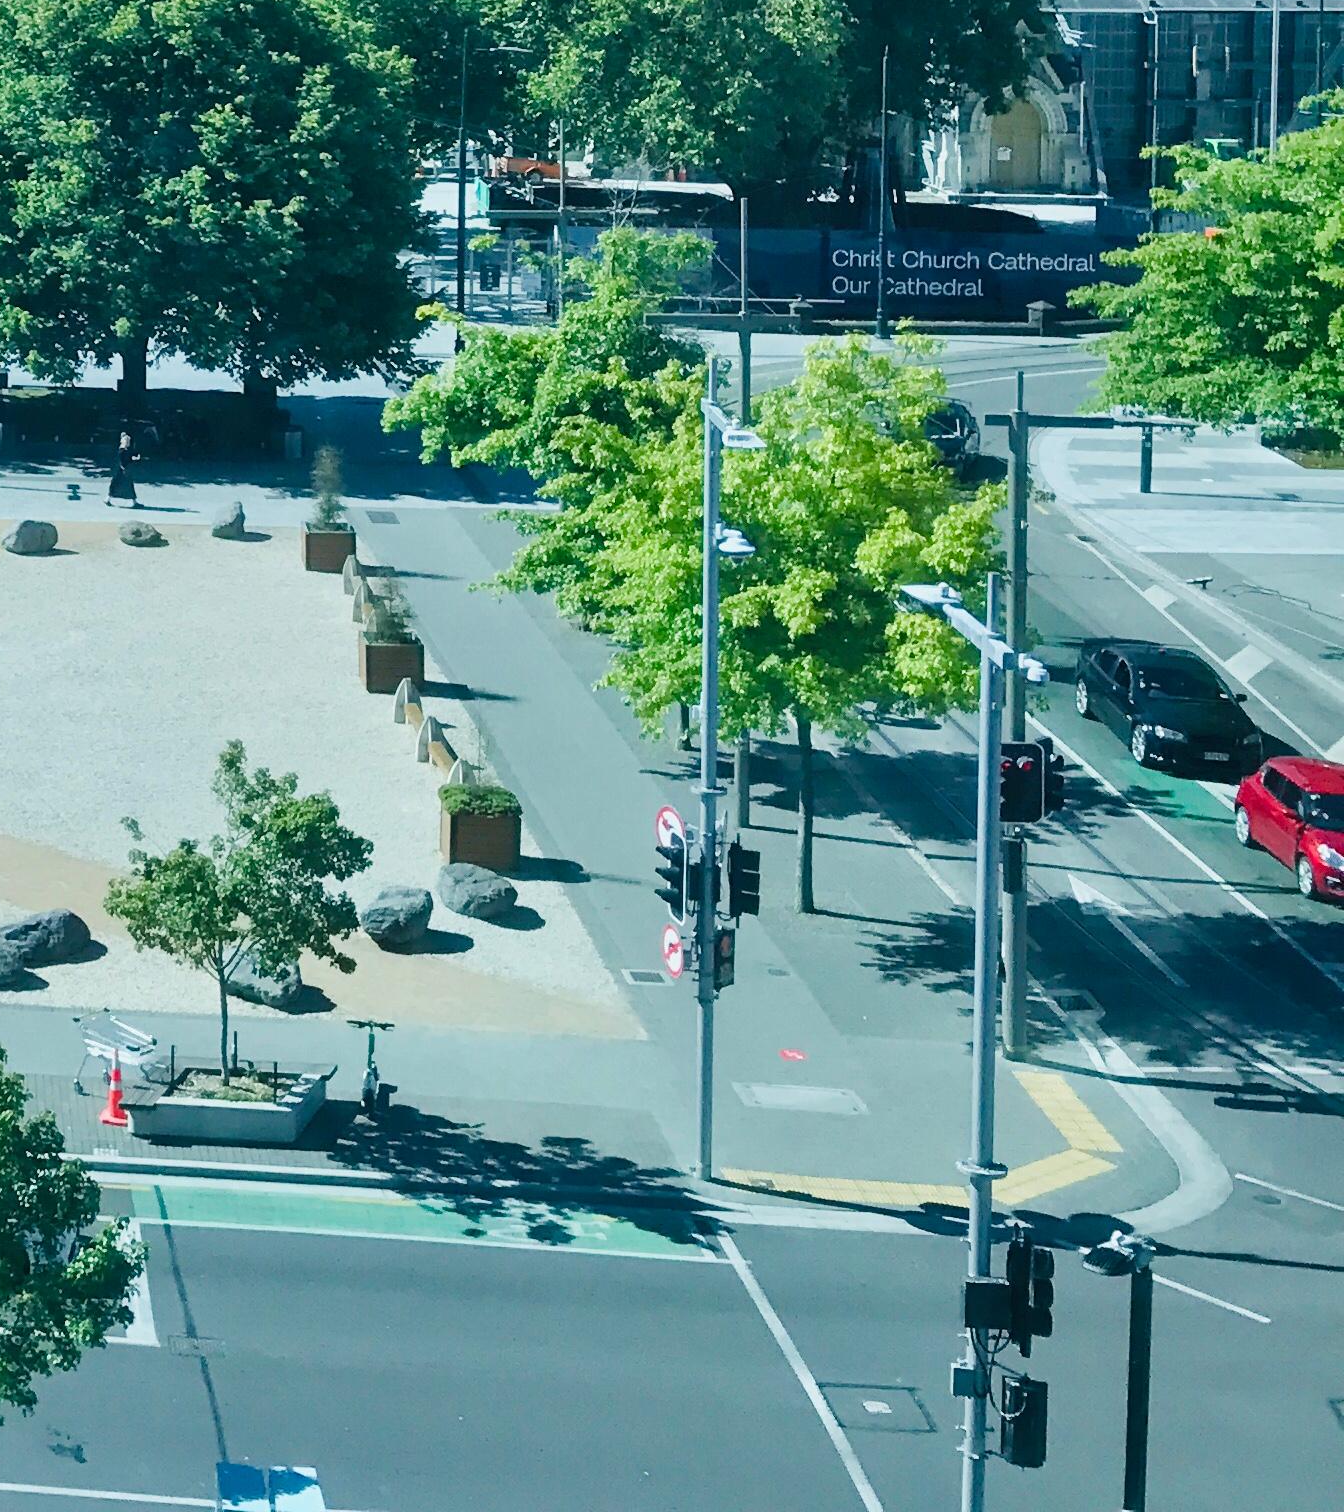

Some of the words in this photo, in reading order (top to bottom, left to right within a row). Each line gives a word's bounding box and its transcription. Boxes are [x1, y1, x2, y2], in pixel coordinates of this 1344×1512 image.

[902, 250, 980, 270] Church
[987, 252, 1097, 272] Cathedral
[831, 276, 871, 294] Our
